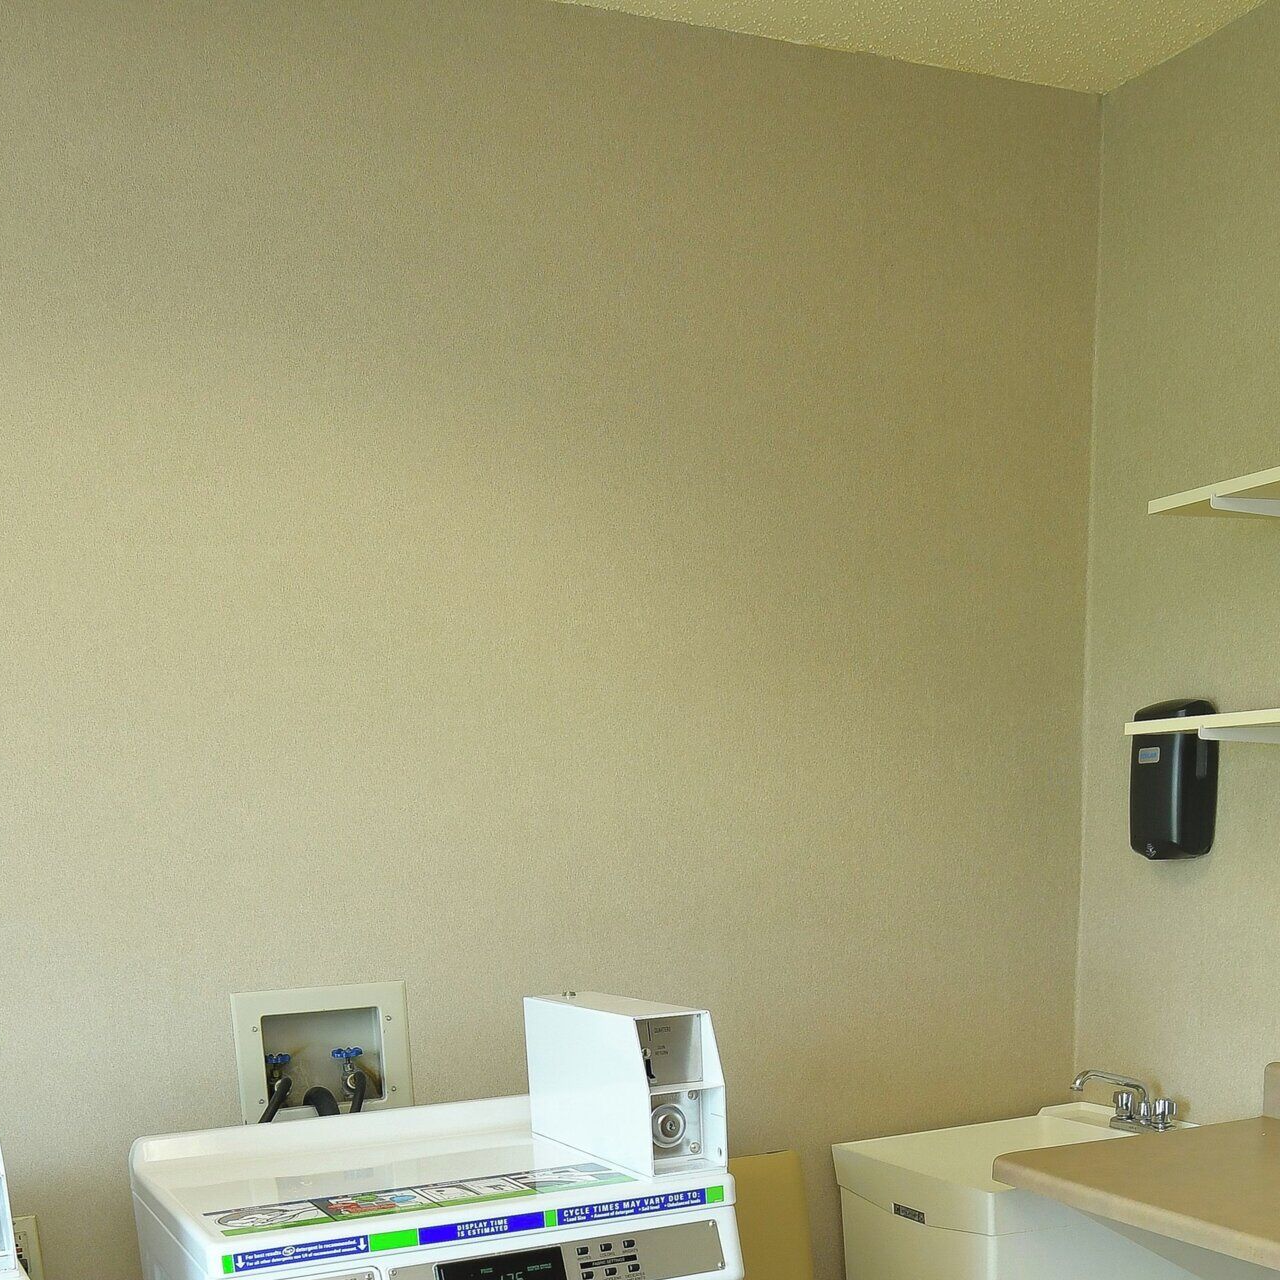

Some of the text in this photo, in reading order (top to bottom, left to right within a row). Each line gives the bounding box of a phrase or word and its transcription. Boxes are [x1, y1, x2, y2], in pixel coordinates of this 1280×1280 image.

[563, 1191, 700, 1217] CYCLE TIMES MAY VARY DUE TO:
[456, 1218, 508, 1231] DISPLAY TIME
[457, 1224, 508, 1238] IS ESTIMATED
